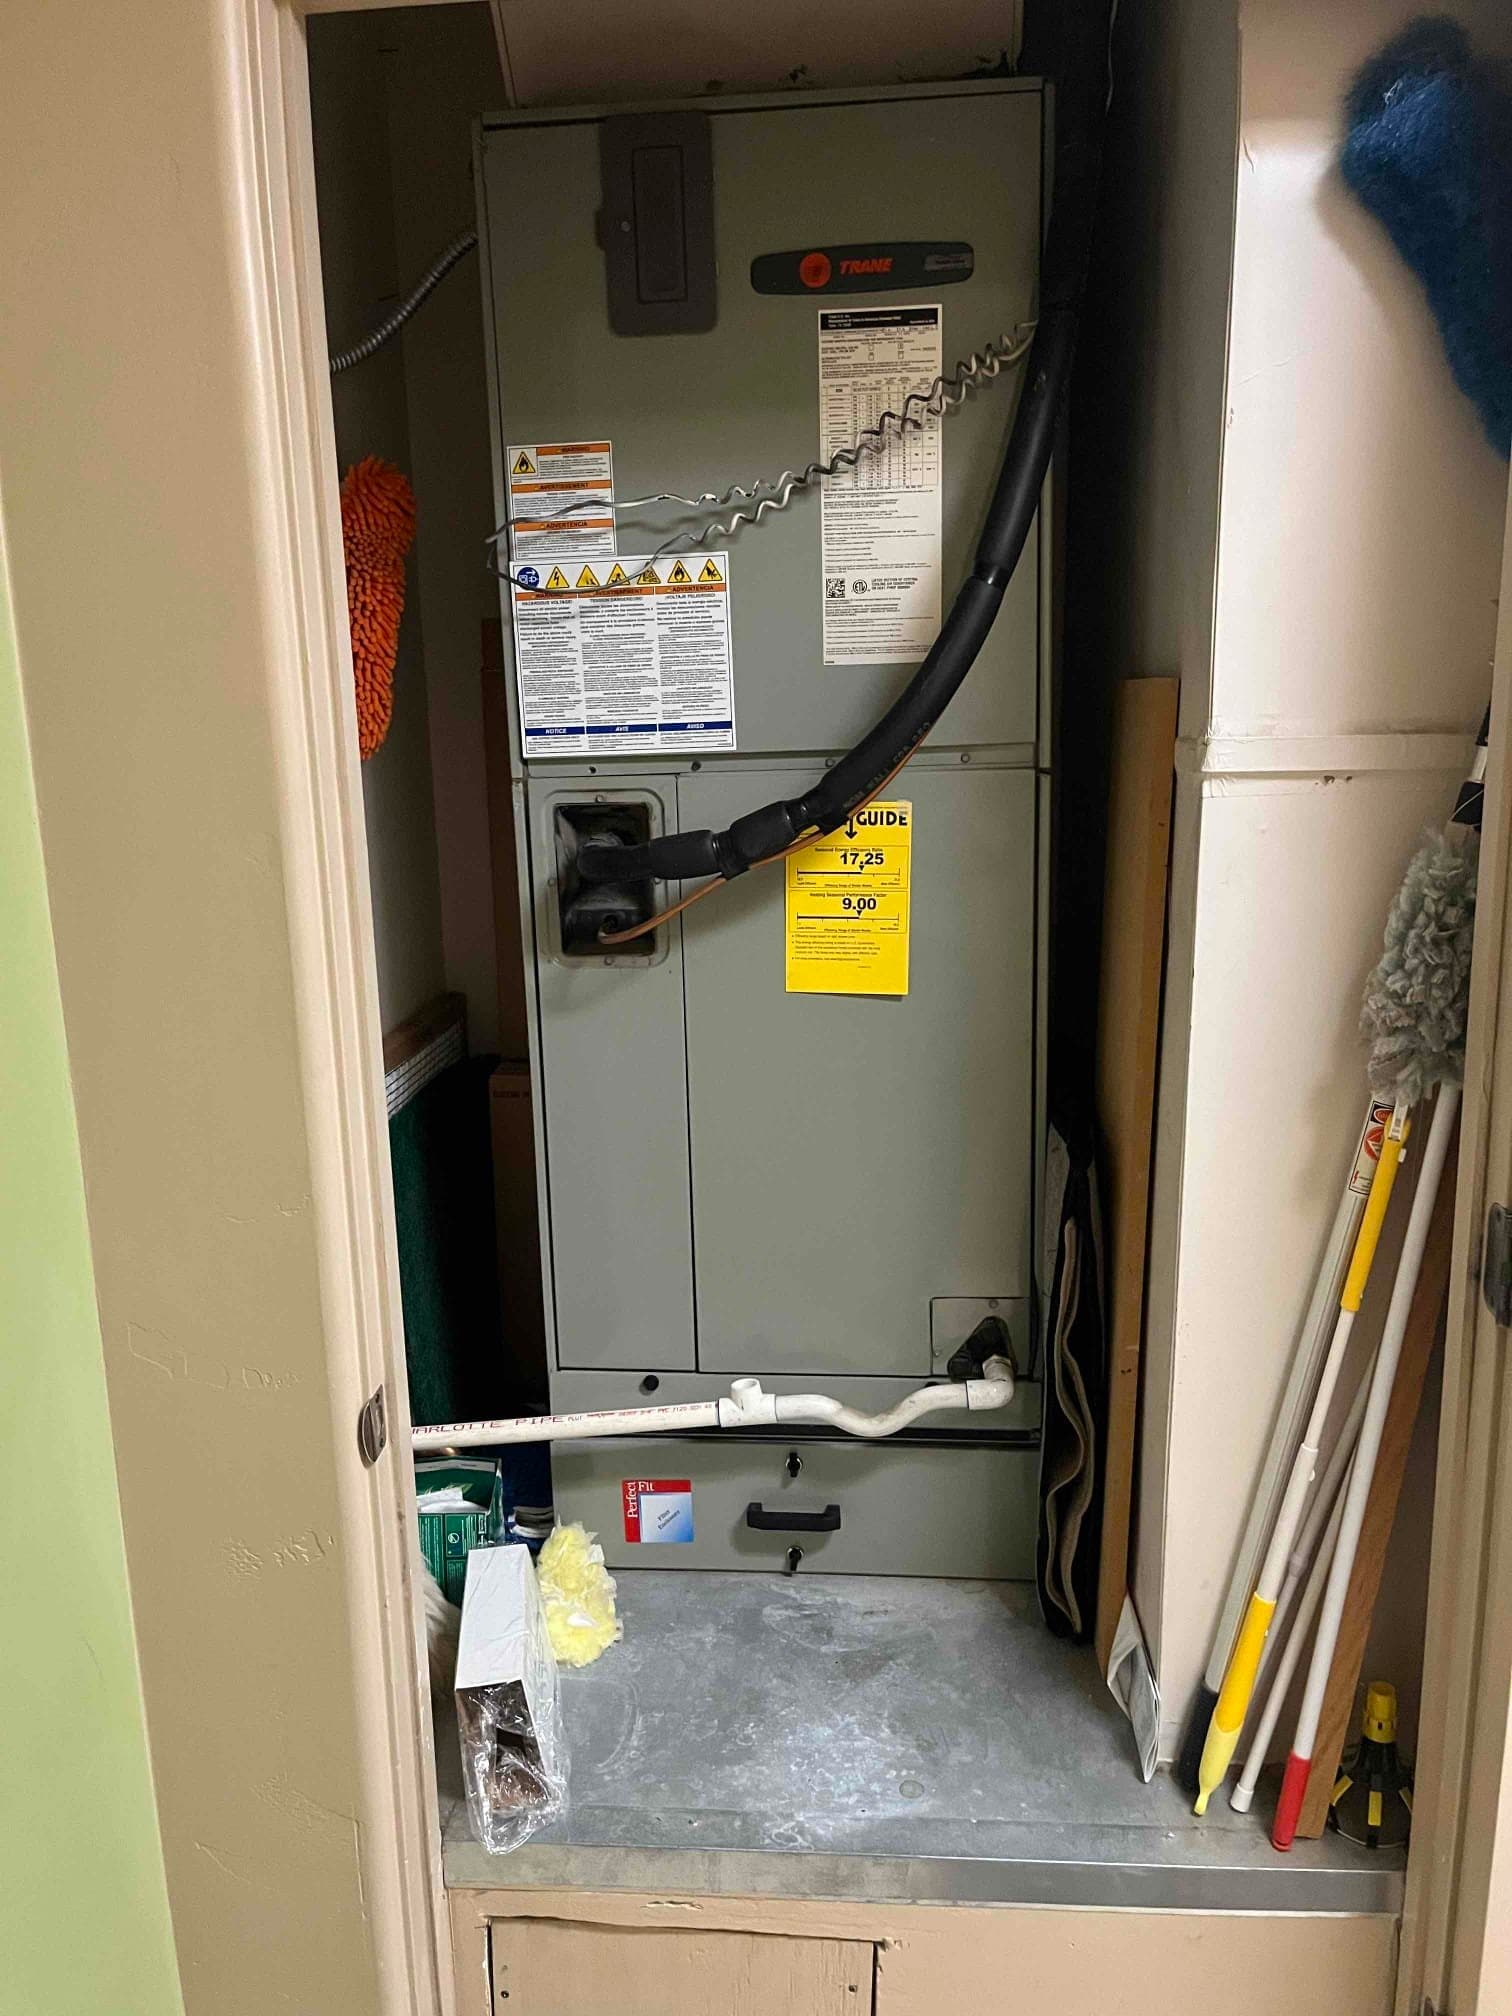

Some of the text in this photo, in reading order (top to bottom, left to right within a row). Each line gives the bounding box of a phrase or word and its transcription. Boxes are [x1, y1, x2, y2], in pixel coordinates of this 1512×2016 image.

[839, 257, 893, 275] TRANE
[546, 520, 588, 529] ADVERTENCIA
[672, 585, 714, 593] ADVERTENCIA
[840, 852, 884, 865] 17.25
[842, 897, 877, 910] 9.00
[412, 1421, 503, 1434] HARLOTTE
[515, 1415, 565, 1426] PIPE
[625, 1481, 655, 1518] Perfect Fit
